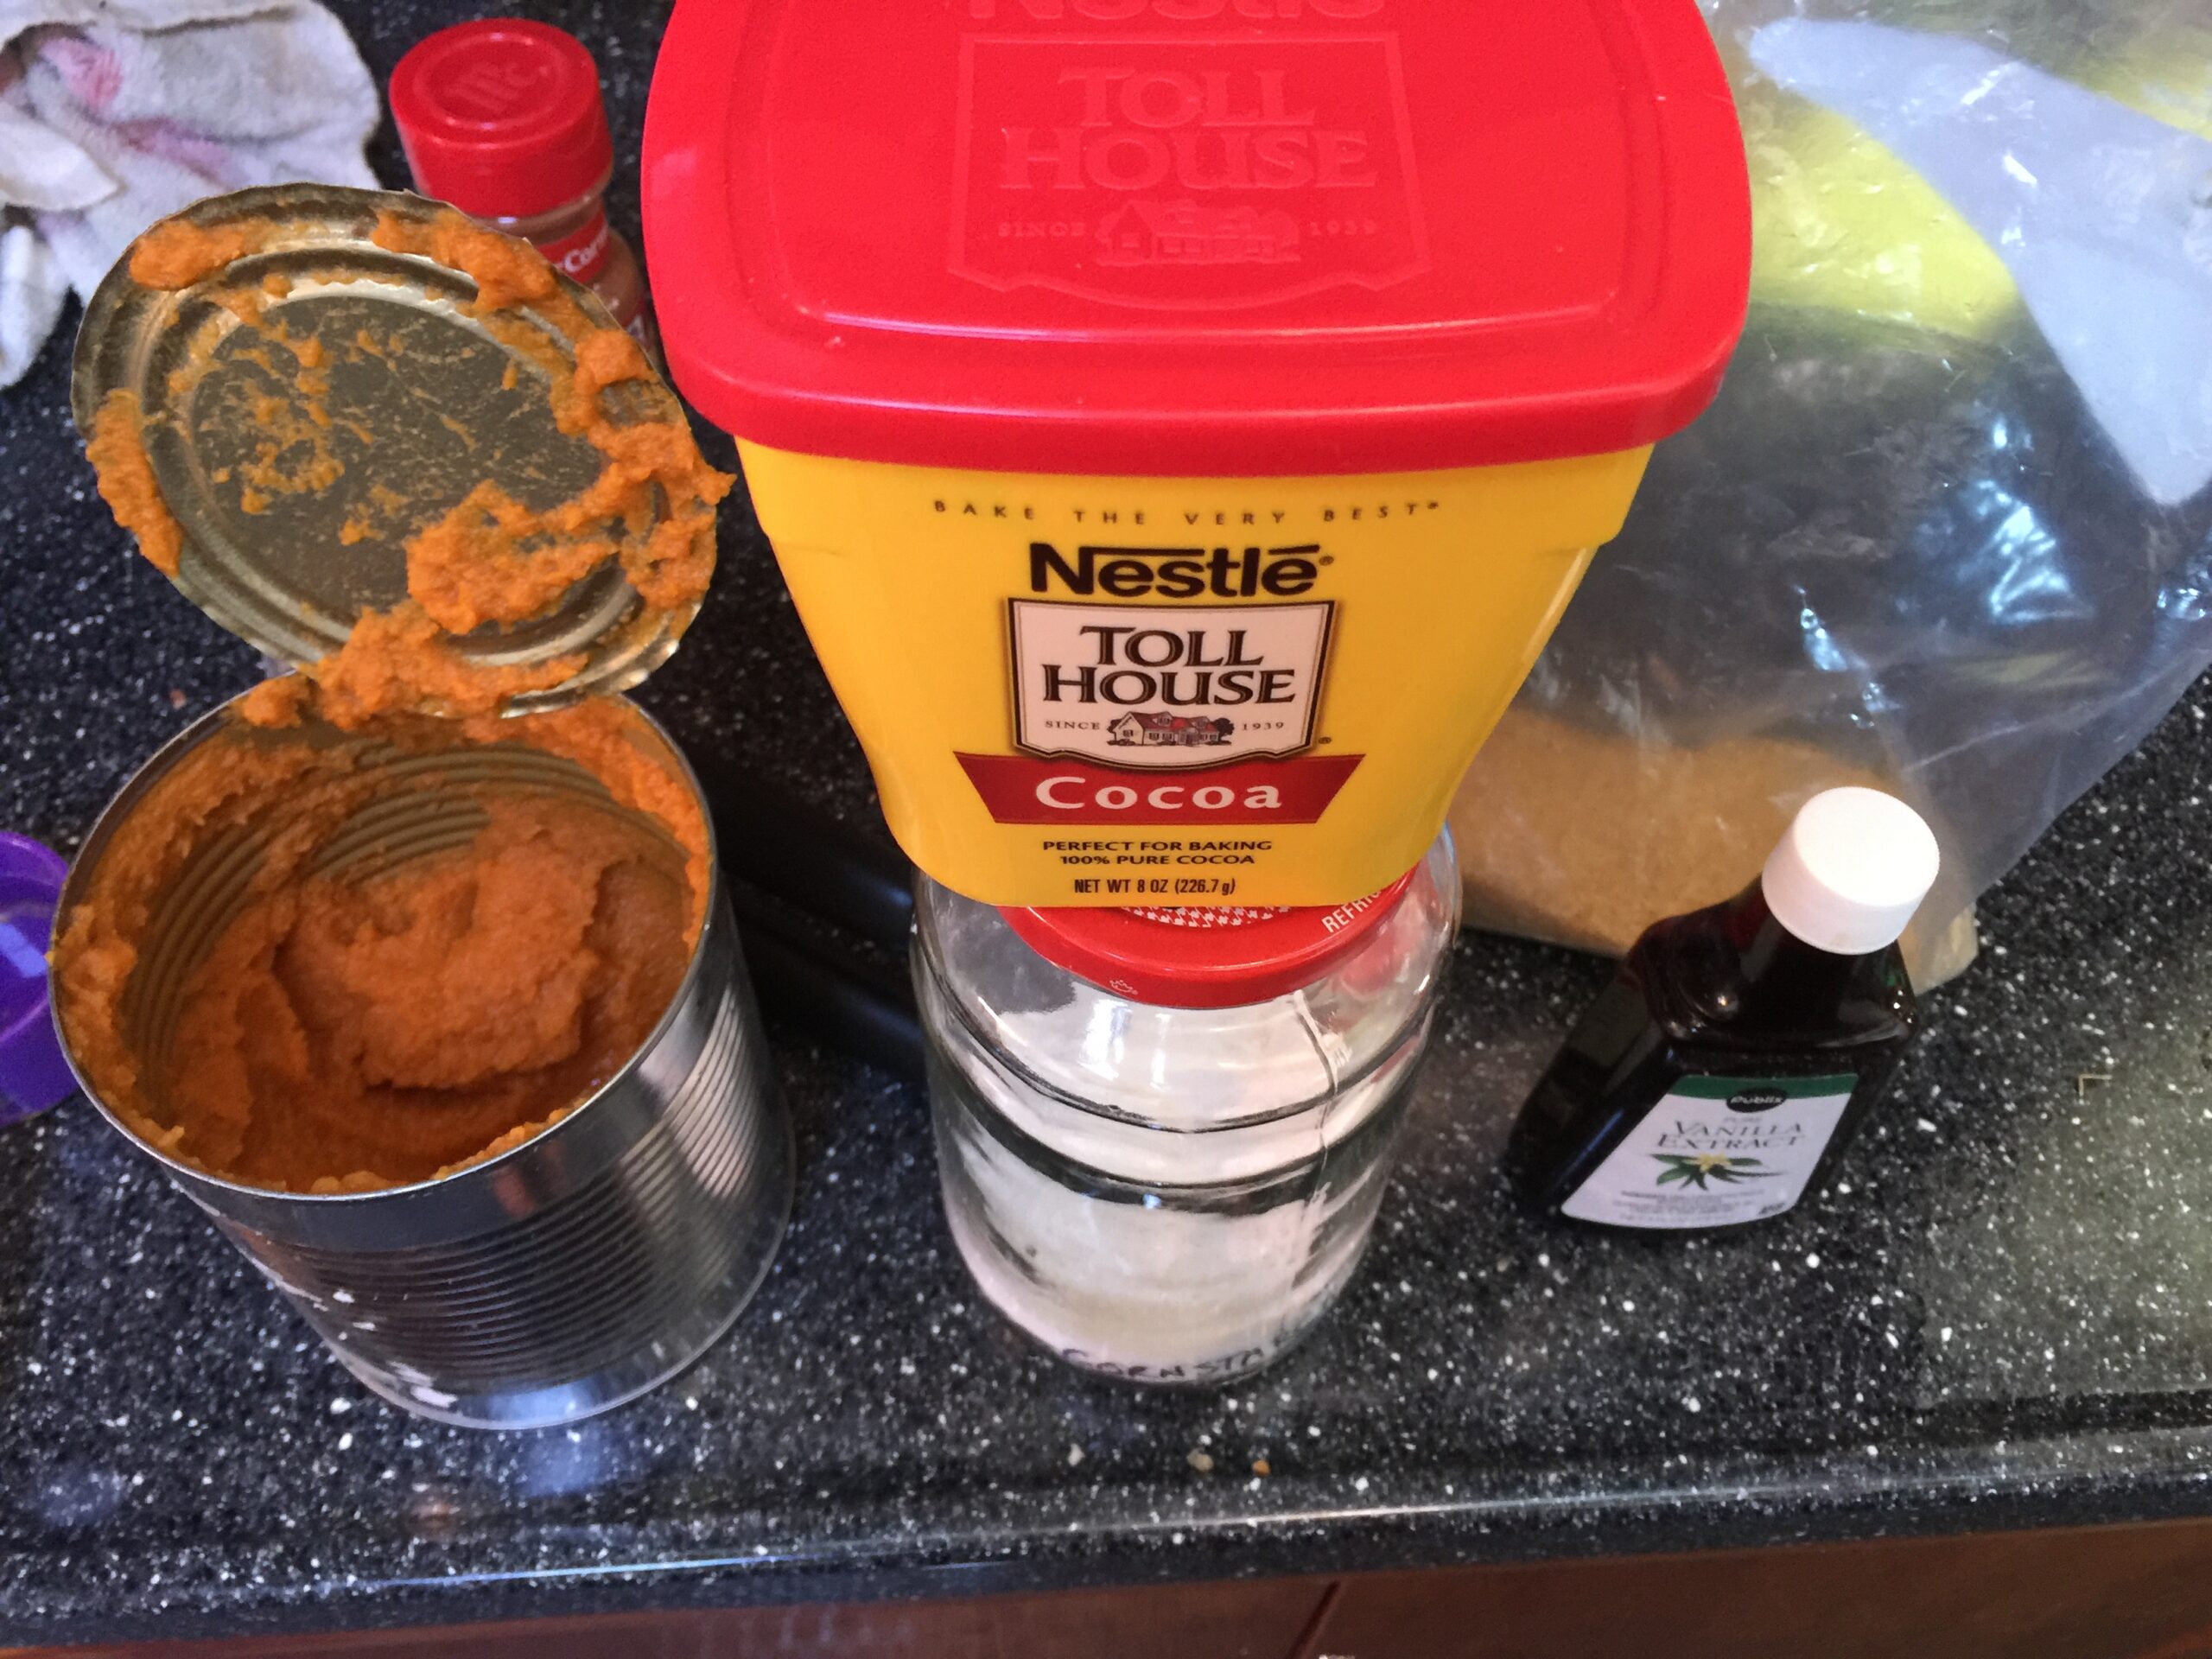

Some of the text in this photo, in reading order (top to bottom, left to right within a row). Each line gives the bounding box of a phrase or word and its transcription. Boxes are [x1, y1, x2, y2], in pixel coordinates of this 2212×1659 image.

[1058, 67, 1314, 128] TOLL
[1000, 126, 1376, 190] HOUSE
[1310, 219, 1378, 236] 1939
[934, 500, 1034, 520] BAKE
[1074, 508, 1145, 525] THE
[1184, 512, 1285, 525] VERY
[1029, 542, 1320, 598] Nestlé
[1080, 626, 1264, 667] TOLL
[1041, 664, 1296, 706] HOUSE
[1045, 720, 1285, 732] SINCE 1939
[1036, 776, 1282, 810] Cocoa
[1043, 840, 1273, 852] PERFECT FOR BAKING
[1059, 855, 1255, 866] 100% PURE COCOA
[1074, 878, 1102, 894] NET
[1106, 879, 1131, 894] WT
[1137, 879, 1147, 894] 8
[1150, 879, 1168, 894] OZ
[1675, 1121, 1802, 1136] VANILLA
[1656, 1133, 1799, 1150] EXTRACT
